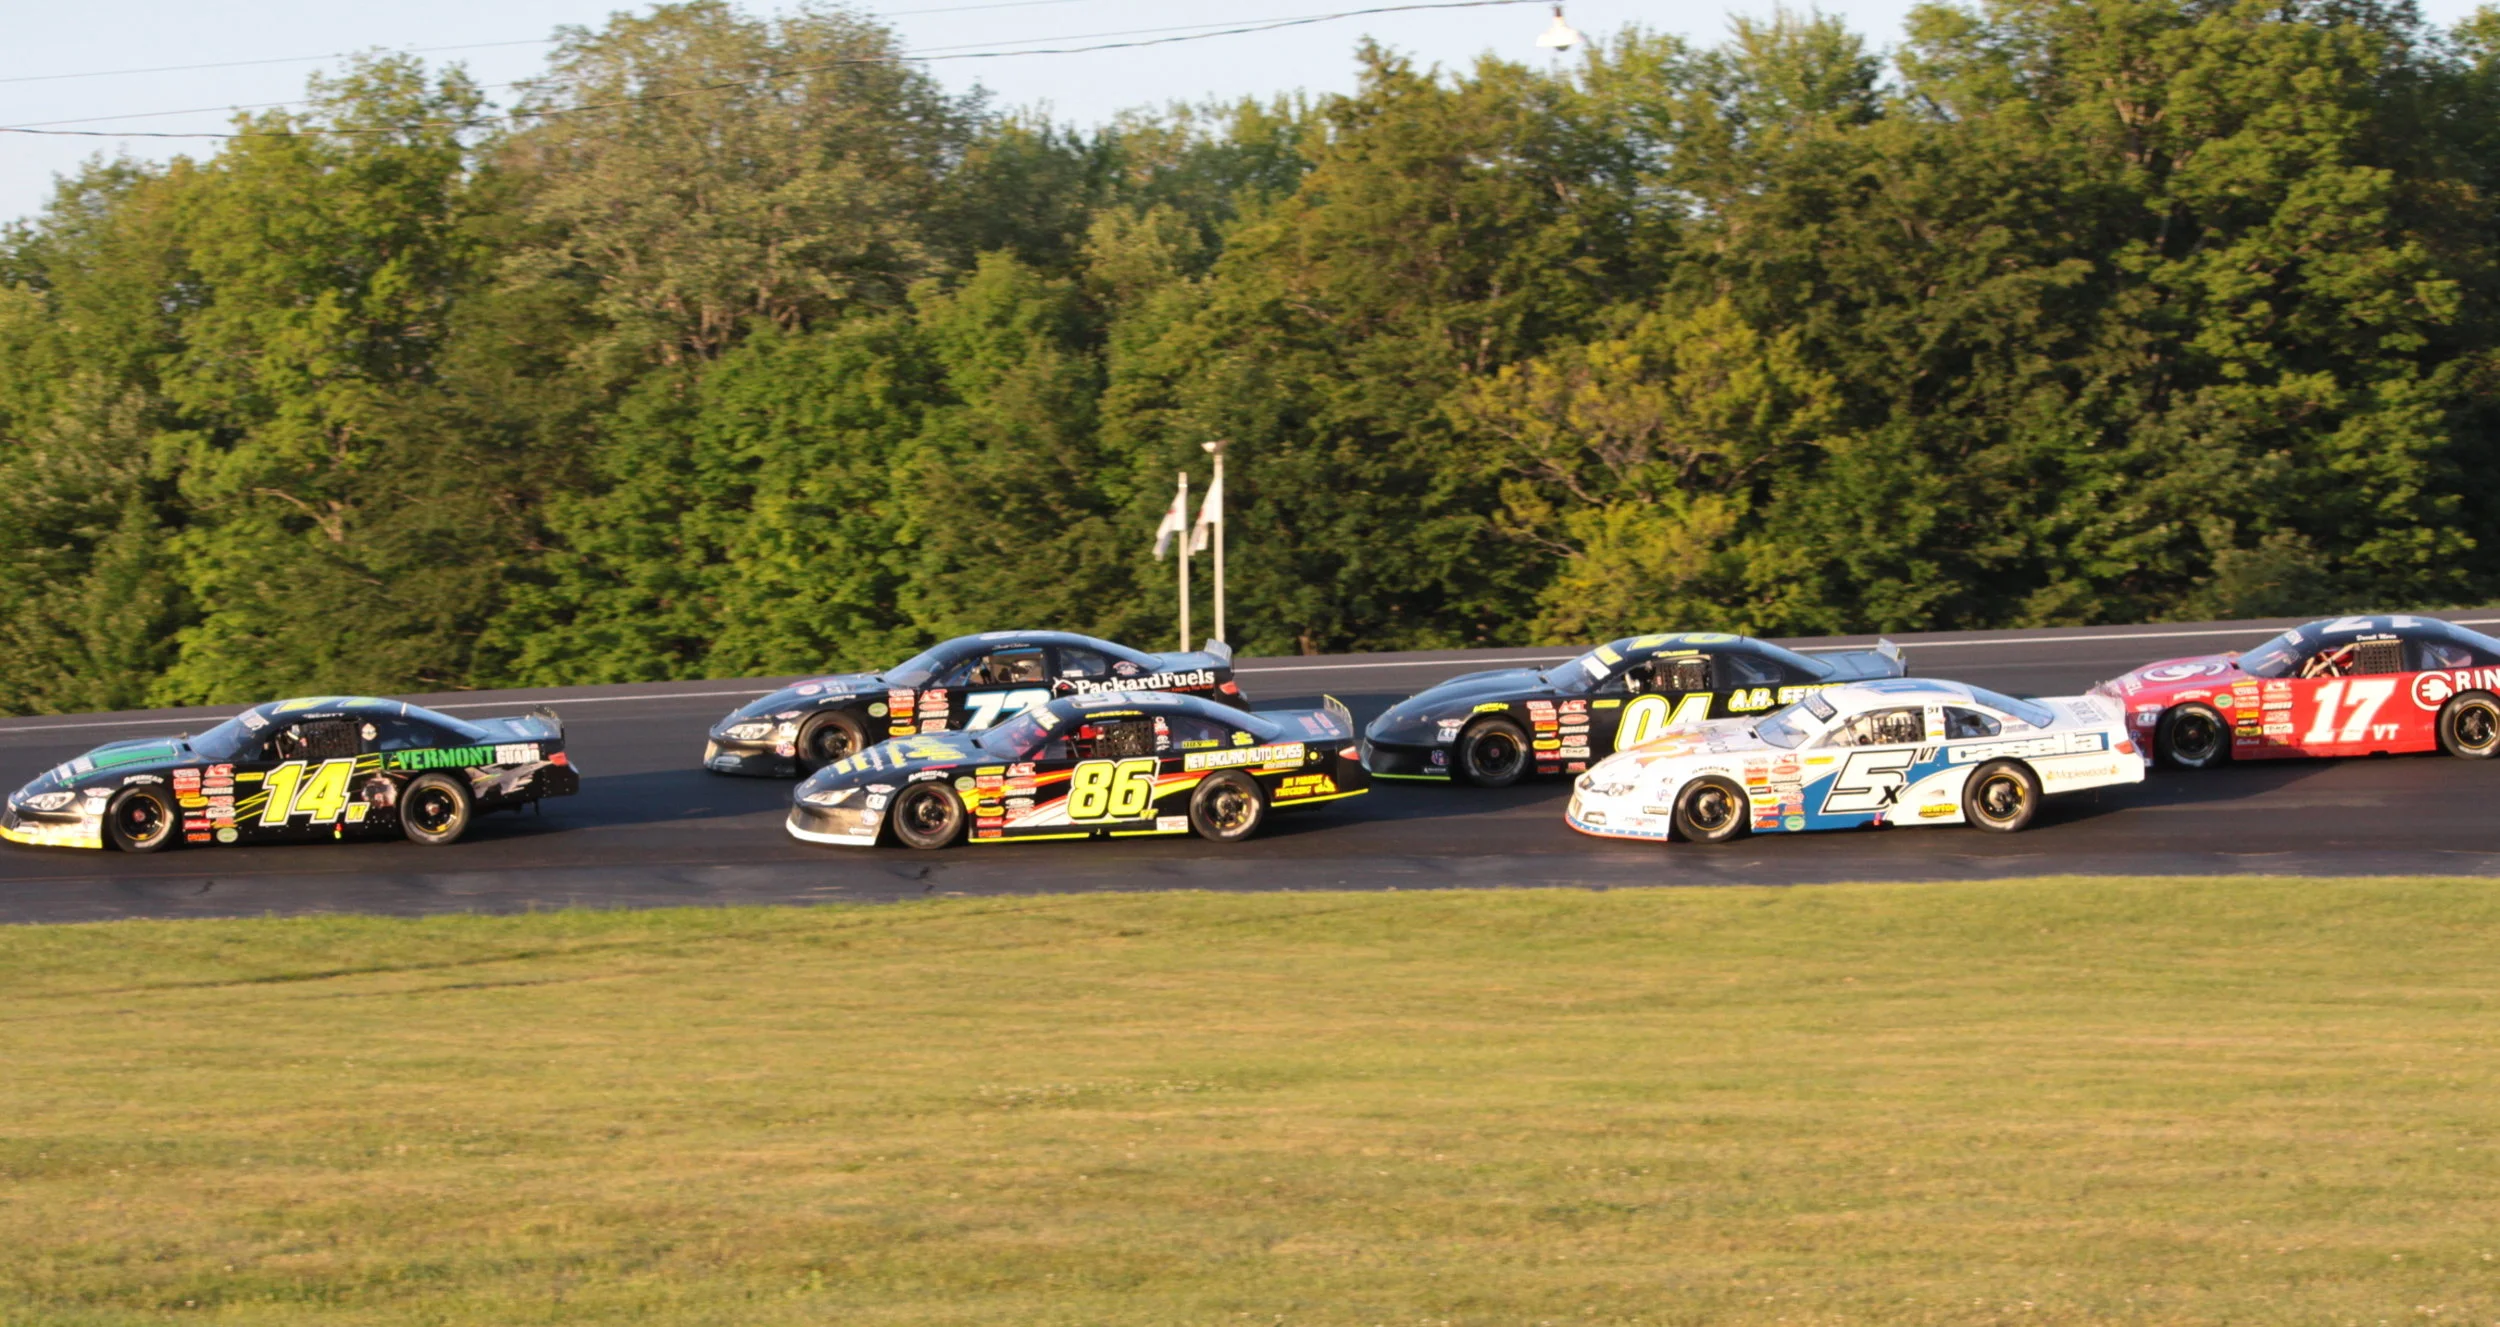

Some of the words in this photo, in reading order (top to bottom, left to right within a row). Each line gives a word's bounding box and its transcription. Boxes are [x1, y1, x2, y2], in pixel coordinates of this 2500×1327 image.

[1076, 669, 1215, 696] PackardFuels
[2303, 679, 2399, 744] 17
[2372, 724, 2399, 741] VT
[397, 746, 494, 770] VERMONT
[1207, 749, 1247, 768] ENGLAND
[1248, 746, 1272, 763] AUTO
[1274, 744, 1303, 760] GLASS
[1820, 748, 1917, 814] 5
[1917, 746, 1938, 762] VT
[259, 758, 357, 826] 14
[1068, 757, 1159, 824] 86
